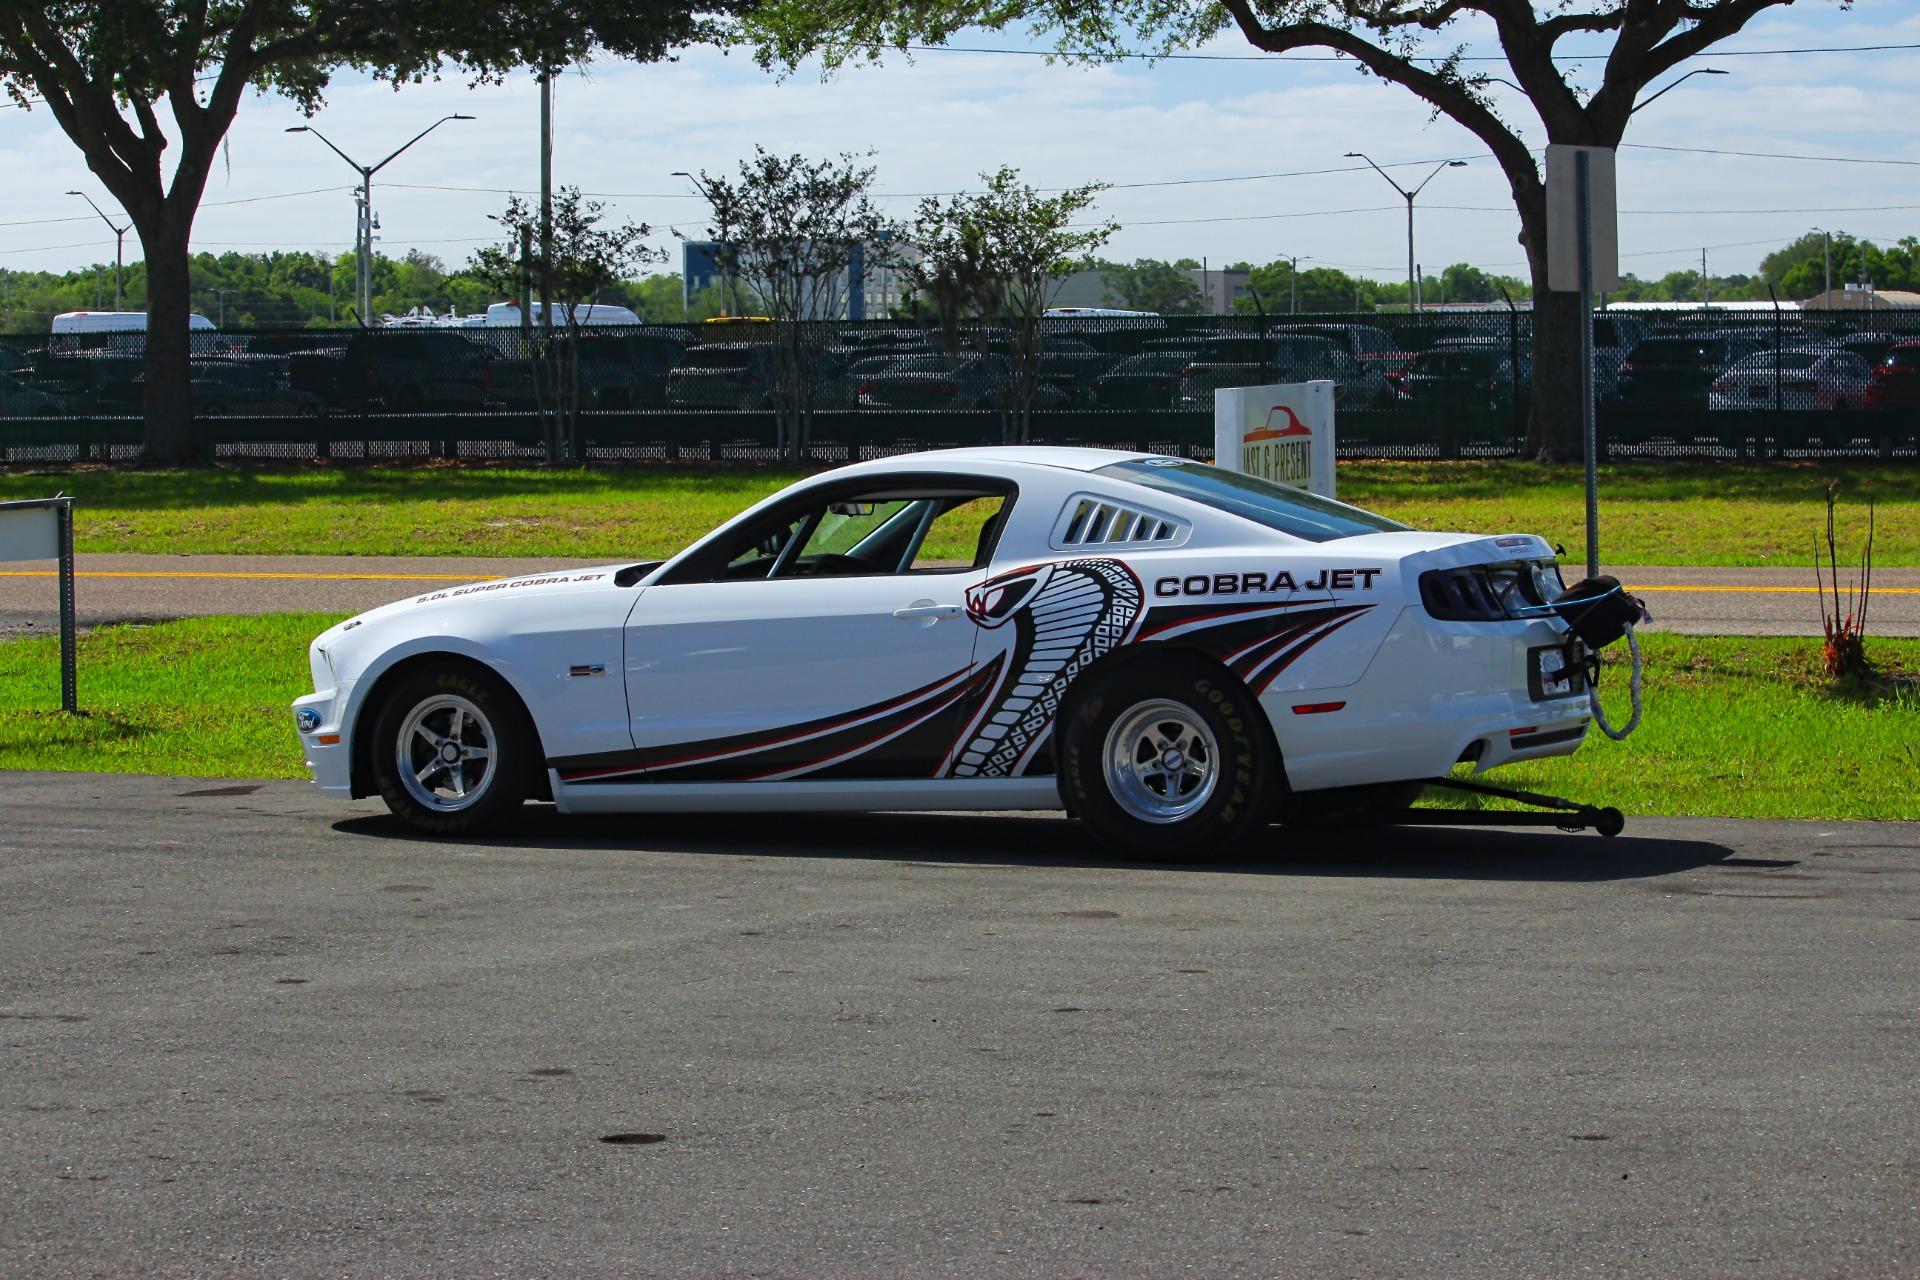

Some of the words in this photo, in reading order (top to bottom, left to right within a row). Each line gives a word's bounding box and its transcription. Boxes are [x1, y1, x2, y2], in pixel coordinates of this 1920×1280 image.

[1274, 440, 1312, 482] PRESENT
[416, 592, 448, 604] 5.0L
[452, 582, 508, 597] SUPER
[510, 576, 569, 588] COBRA
[573, 573, 606, 582] JET
[1154, 570, 1300, 598] COBRA
[1304, 568, 1383, 590] JET
